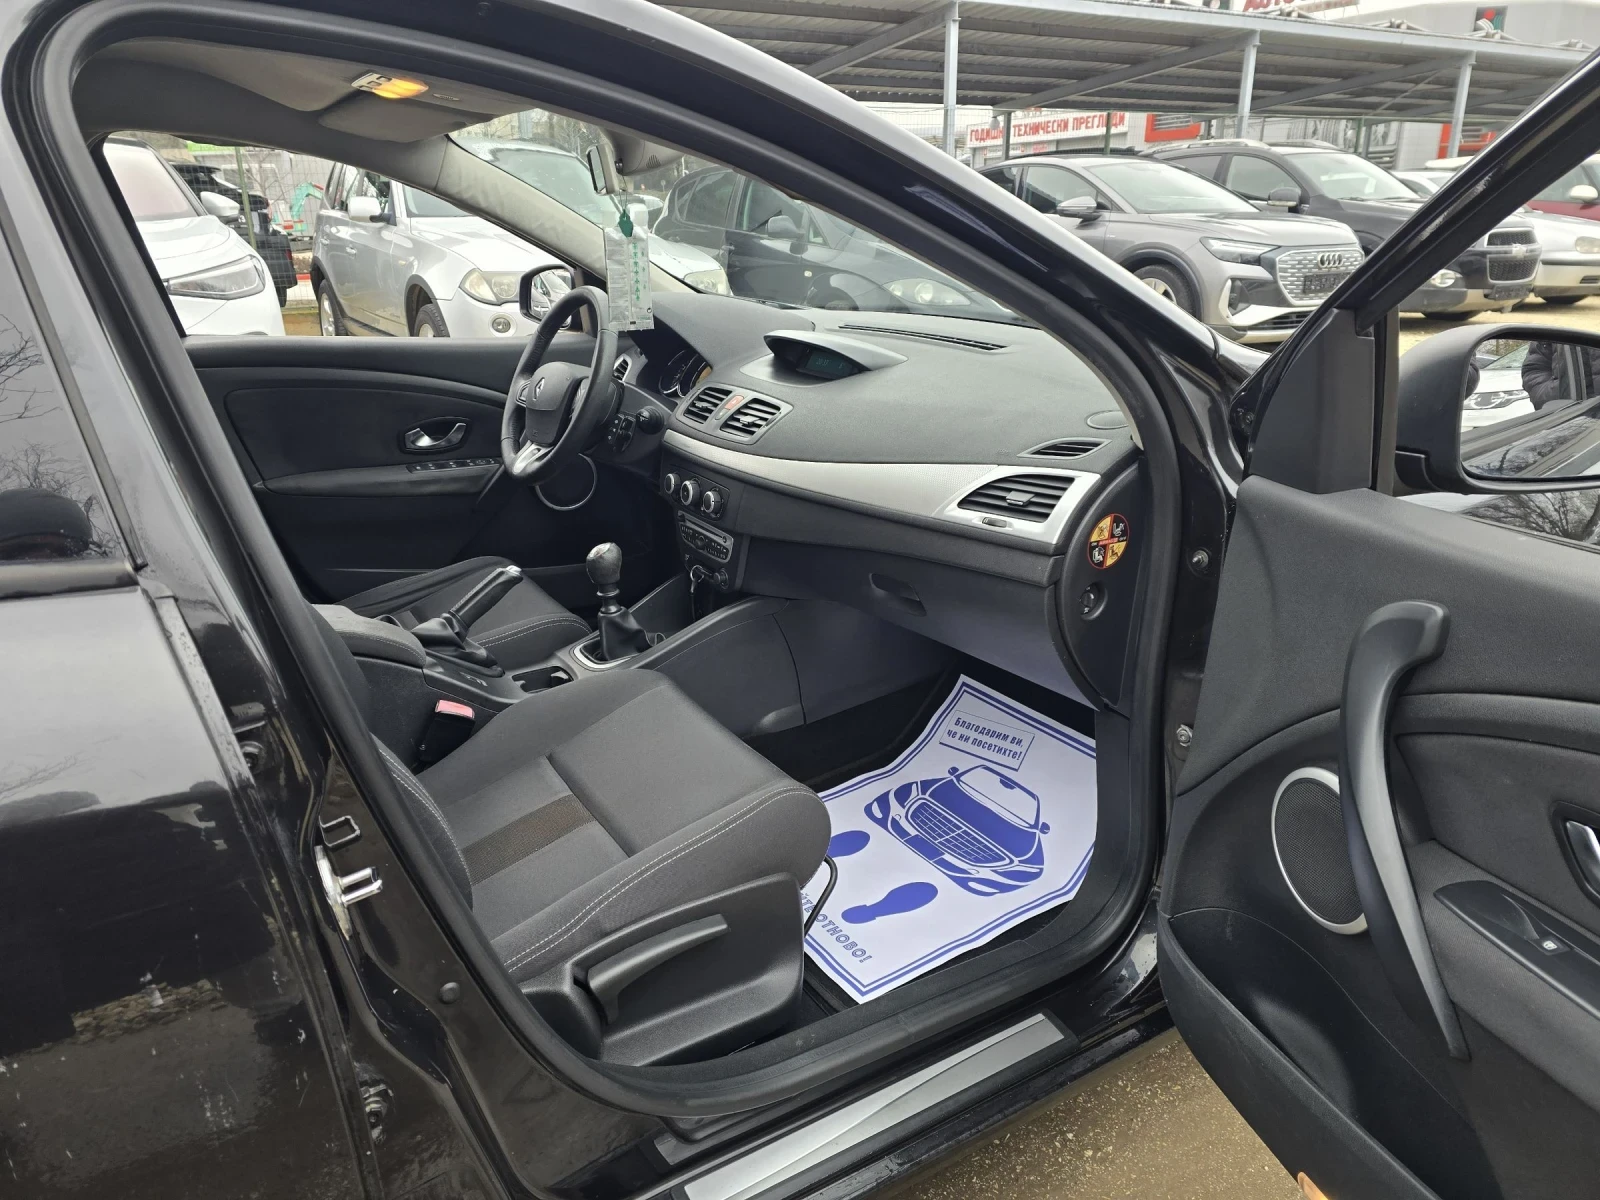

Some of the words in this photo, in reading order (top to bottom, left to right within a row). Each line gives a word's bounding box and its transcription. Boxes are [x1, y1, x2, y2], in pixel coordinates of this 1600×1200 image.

[969, 125, 1004, 143] ГОДИШН
[1012, 117, 1069, 138] ТЕХНИЧЕСКИ
[954, 717, 1010, 742] Благодарим
[946, 729, 958, 738] че
[958, 732, 970, 743] ни
[971, 738, 1023, 760] посетихте!
[815, 913, 873, 963] ОТНОВО!
